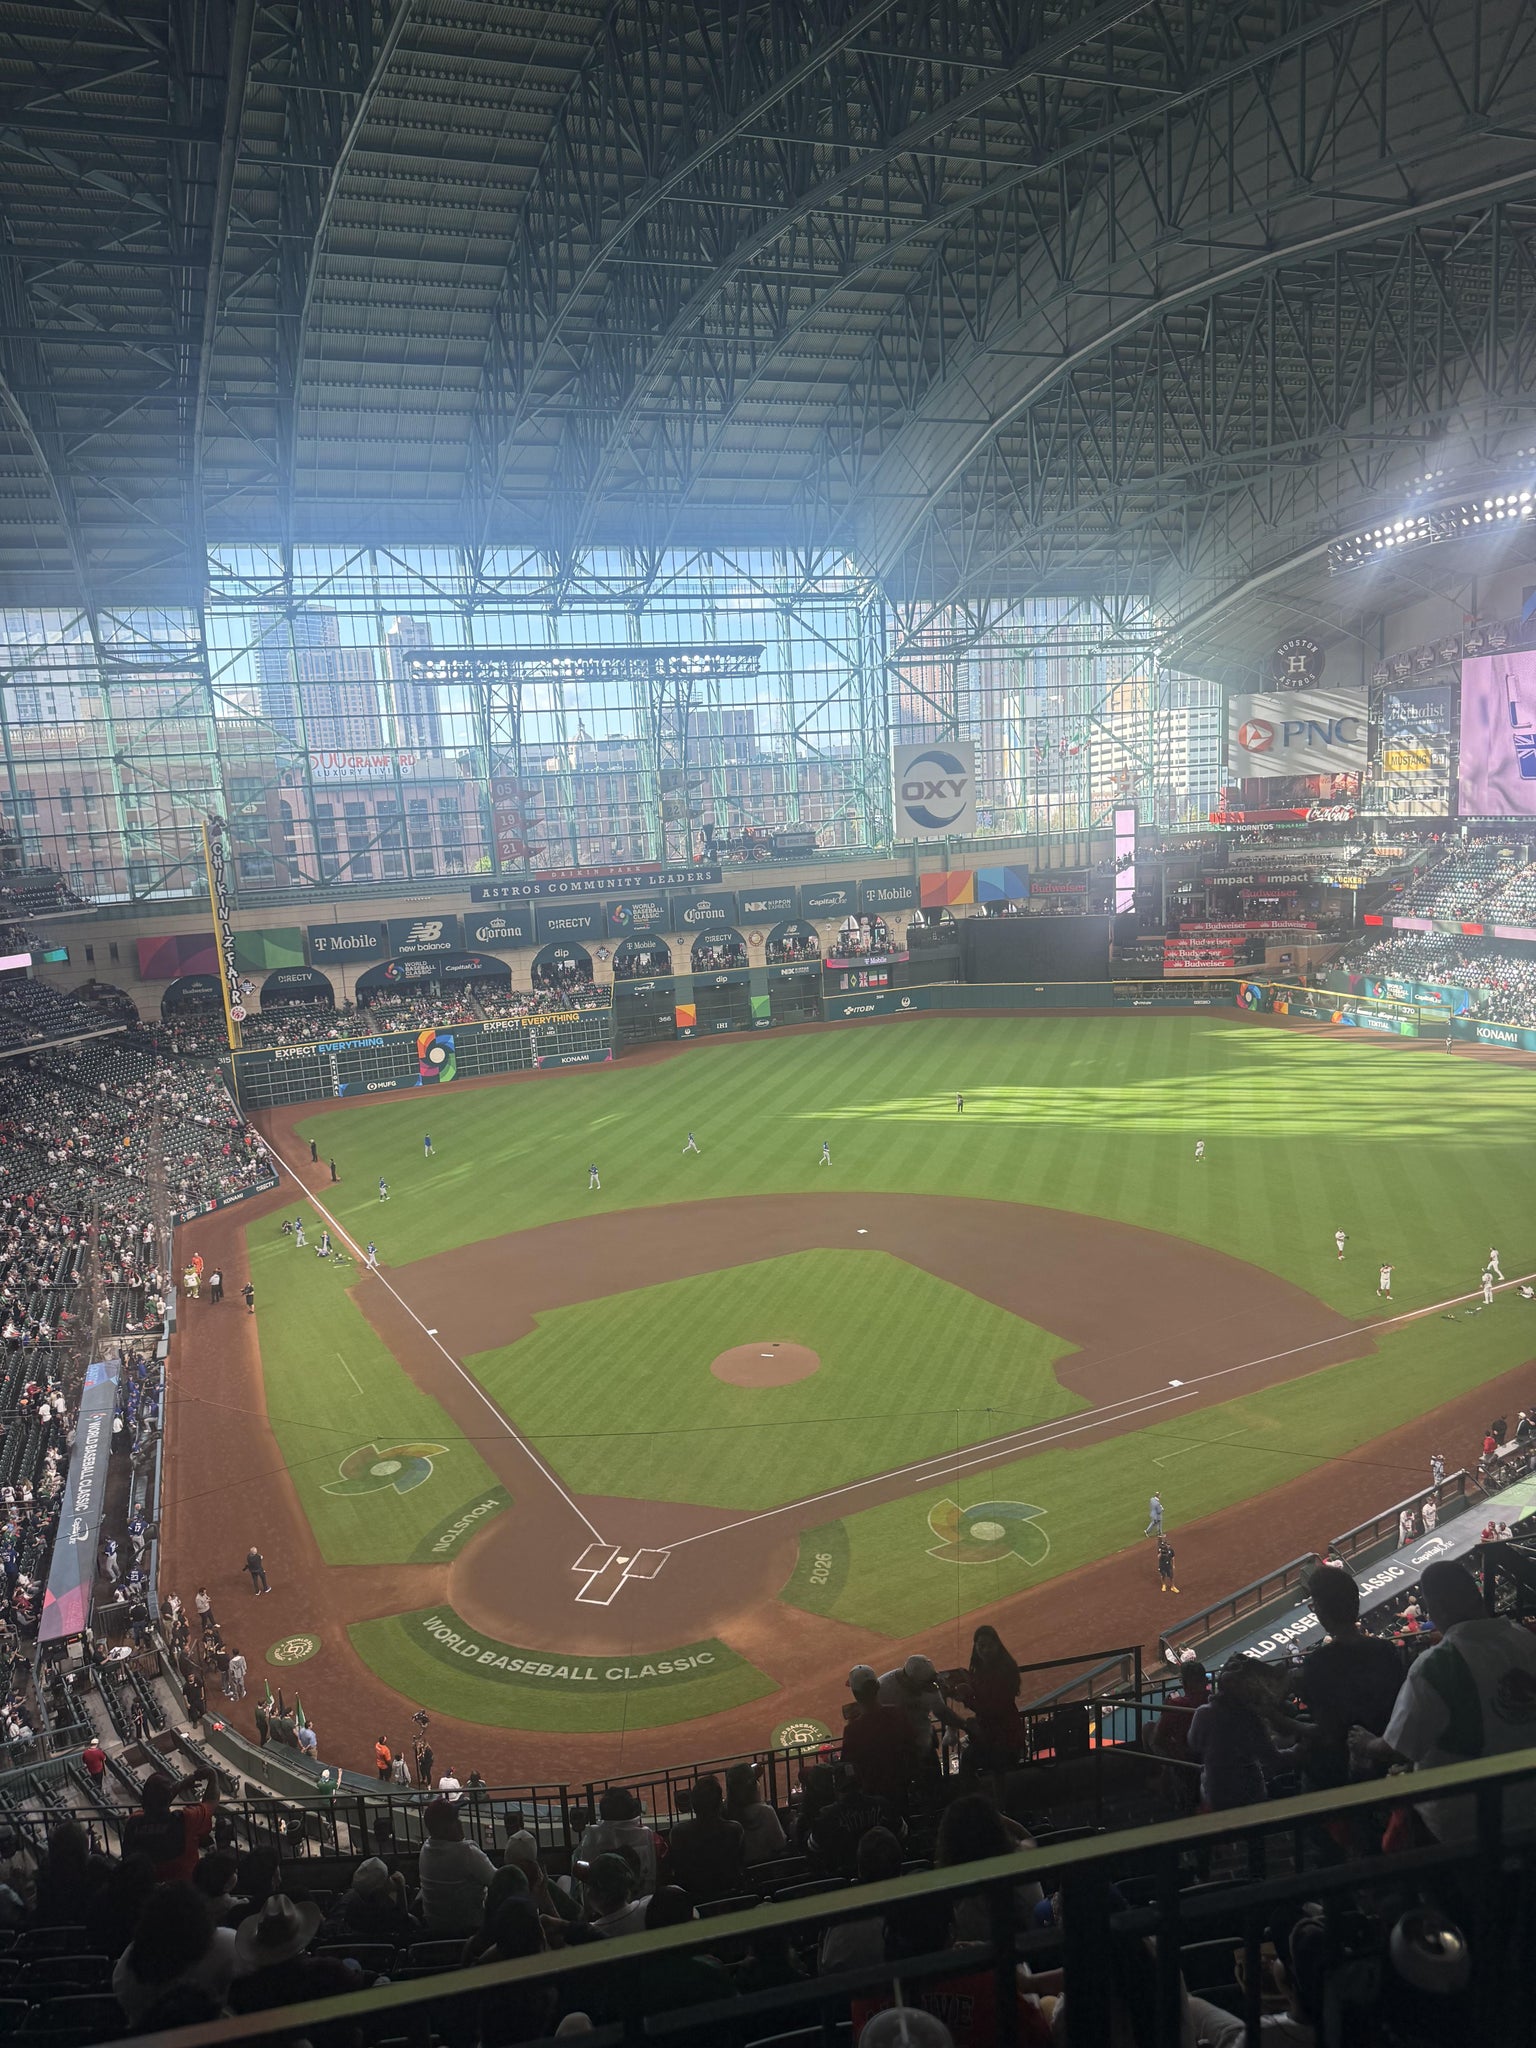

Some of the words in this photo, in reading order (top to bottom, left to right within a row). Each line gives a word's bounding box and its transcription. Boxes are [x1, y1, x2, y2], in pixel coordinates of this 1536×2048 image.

[1278, 640, 1318, 656] HOUSTON
[1287, 655, 1307, 673] H
[1279, 673, 1316, 687] ASTROS
[1388, 702, 1444, 721] Methodist
[1280, 716, 1361, 748] PNC
[347, 755, 417, 768] CRAWFRD
[1391, 754, 1427, 766] MUSTANG
[317, 768, 363, 777] LUXURY
[368, 766, 409, 776] LIVIG
[664, 775, 679, 786] 17
[496, 784, 513, 796] 05
[902, 779, 969, 801] OXY
[667, 805, 681, 816] 22
[501, 814, 516, 826] 19
[1236, 824, 1274, 832] HORNITOS
[503, 843, 517, 855] 21
[551, 869, 600, 878] DAIKIN
[610, 866, 641, 874] PARK
[211, 843, 229, 921] CHIKIN
[1213, 875, 1255, 886] impact
[1267, 873, 1309, 884] impact
[482, 885, 541, 898] ASTROS
[548, 877, 642, 893] COMMUNITY
[649, 872, 712, 885] LEADERS
[1030, 883, 1086, 894] Budweiser
[878, 887, 912, 901] Mobile
[632, 902, 656, 910] WORLD
[683, 908, 725, 924] Corona
[548, 917, 592, 930] DIRECTV
[1204, 922, 1248, 930] Budweiser
[1271, 920, 1307, 929] Budweiser
[223, 923, 235, 948] IZ
[476, 925, 522, 943] Corona
[704, 934, 732, 943] DIRECTV
[330, 934, 377, 950] Mobile
[399, 944, 416, 953] new
[417, 942, 451, 951] balance
[634, 940, 656, 949] Mobile
[1189, 938, 1232, 946] Budweiser
[554, 948, 570, 958] dip
[1184, 960, 1226, 968] Budweiser
[225, 951, 242, 1004] FAIR
[278, 973, 312, 983] DIRECTV
[716, 975, 728, 984] dip
[866, 1004, 875, 1012] EN
[483, 1020, 520, 1031] EXPECT
[521, 1013, 580, 1026] EVERYTHING
[1476, 1026, 1518, 1043] KONAMI
[275, 1045, 317, 1058] EXPECT
[318, 1037, 384, 1053] EVERYTHING
[218, 1057, 232, 1065] 315
[561, 1055, 590, 1063] KONAMI
[377, 1080, 397, 1089] MUFG
[87, 1421, 101, 1446] WORLD
[82, 1444, 99, 1480] BASEBALL
[75, 1478, 92, 1512] CLASSIC
[431, 1500, 500, 1552] HOUSTON
[809, 1553, 833, 1585] 2026
[1242, 1639, 1278, 1660] RLD
[1270, 1612, 1321, 1645] BASE
[1358, 1566, 1406, 1600] LASSIC
[422, 1615, 480, 1657] WORLD
[475, 1650, 599, 1681] BASEBALL
[605, 1651, 716, 1681] CLASSIC
[786, 1723, 819, 1733] BASEBALL
